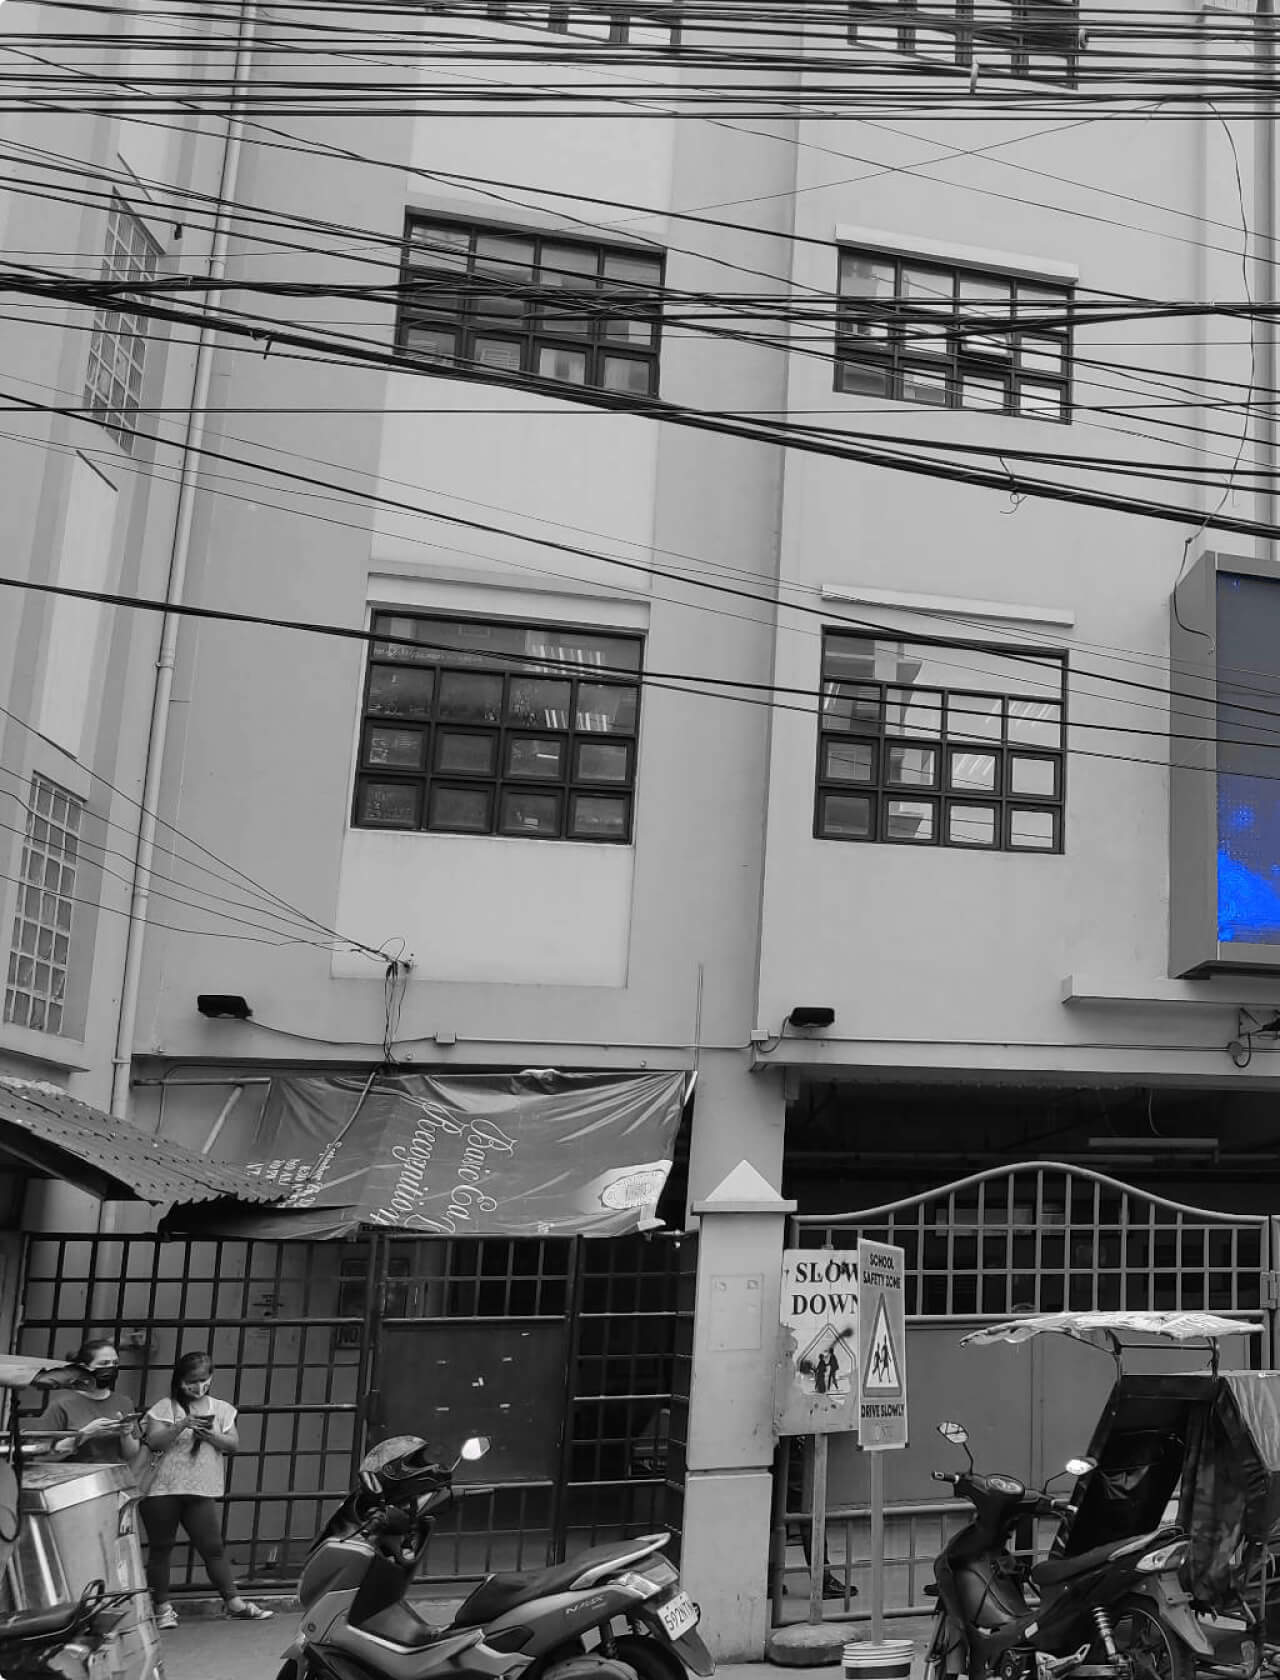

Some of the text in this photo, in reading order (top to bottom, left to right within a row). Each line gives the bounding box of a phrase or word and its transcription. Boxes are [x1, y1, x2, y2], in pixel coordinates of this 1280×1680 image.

[869, 1253, 895, 1270] SCHOOL
[795, 1261, 858, 1283] SLOW
[861, 1404, 880, 1418] DRIVE
